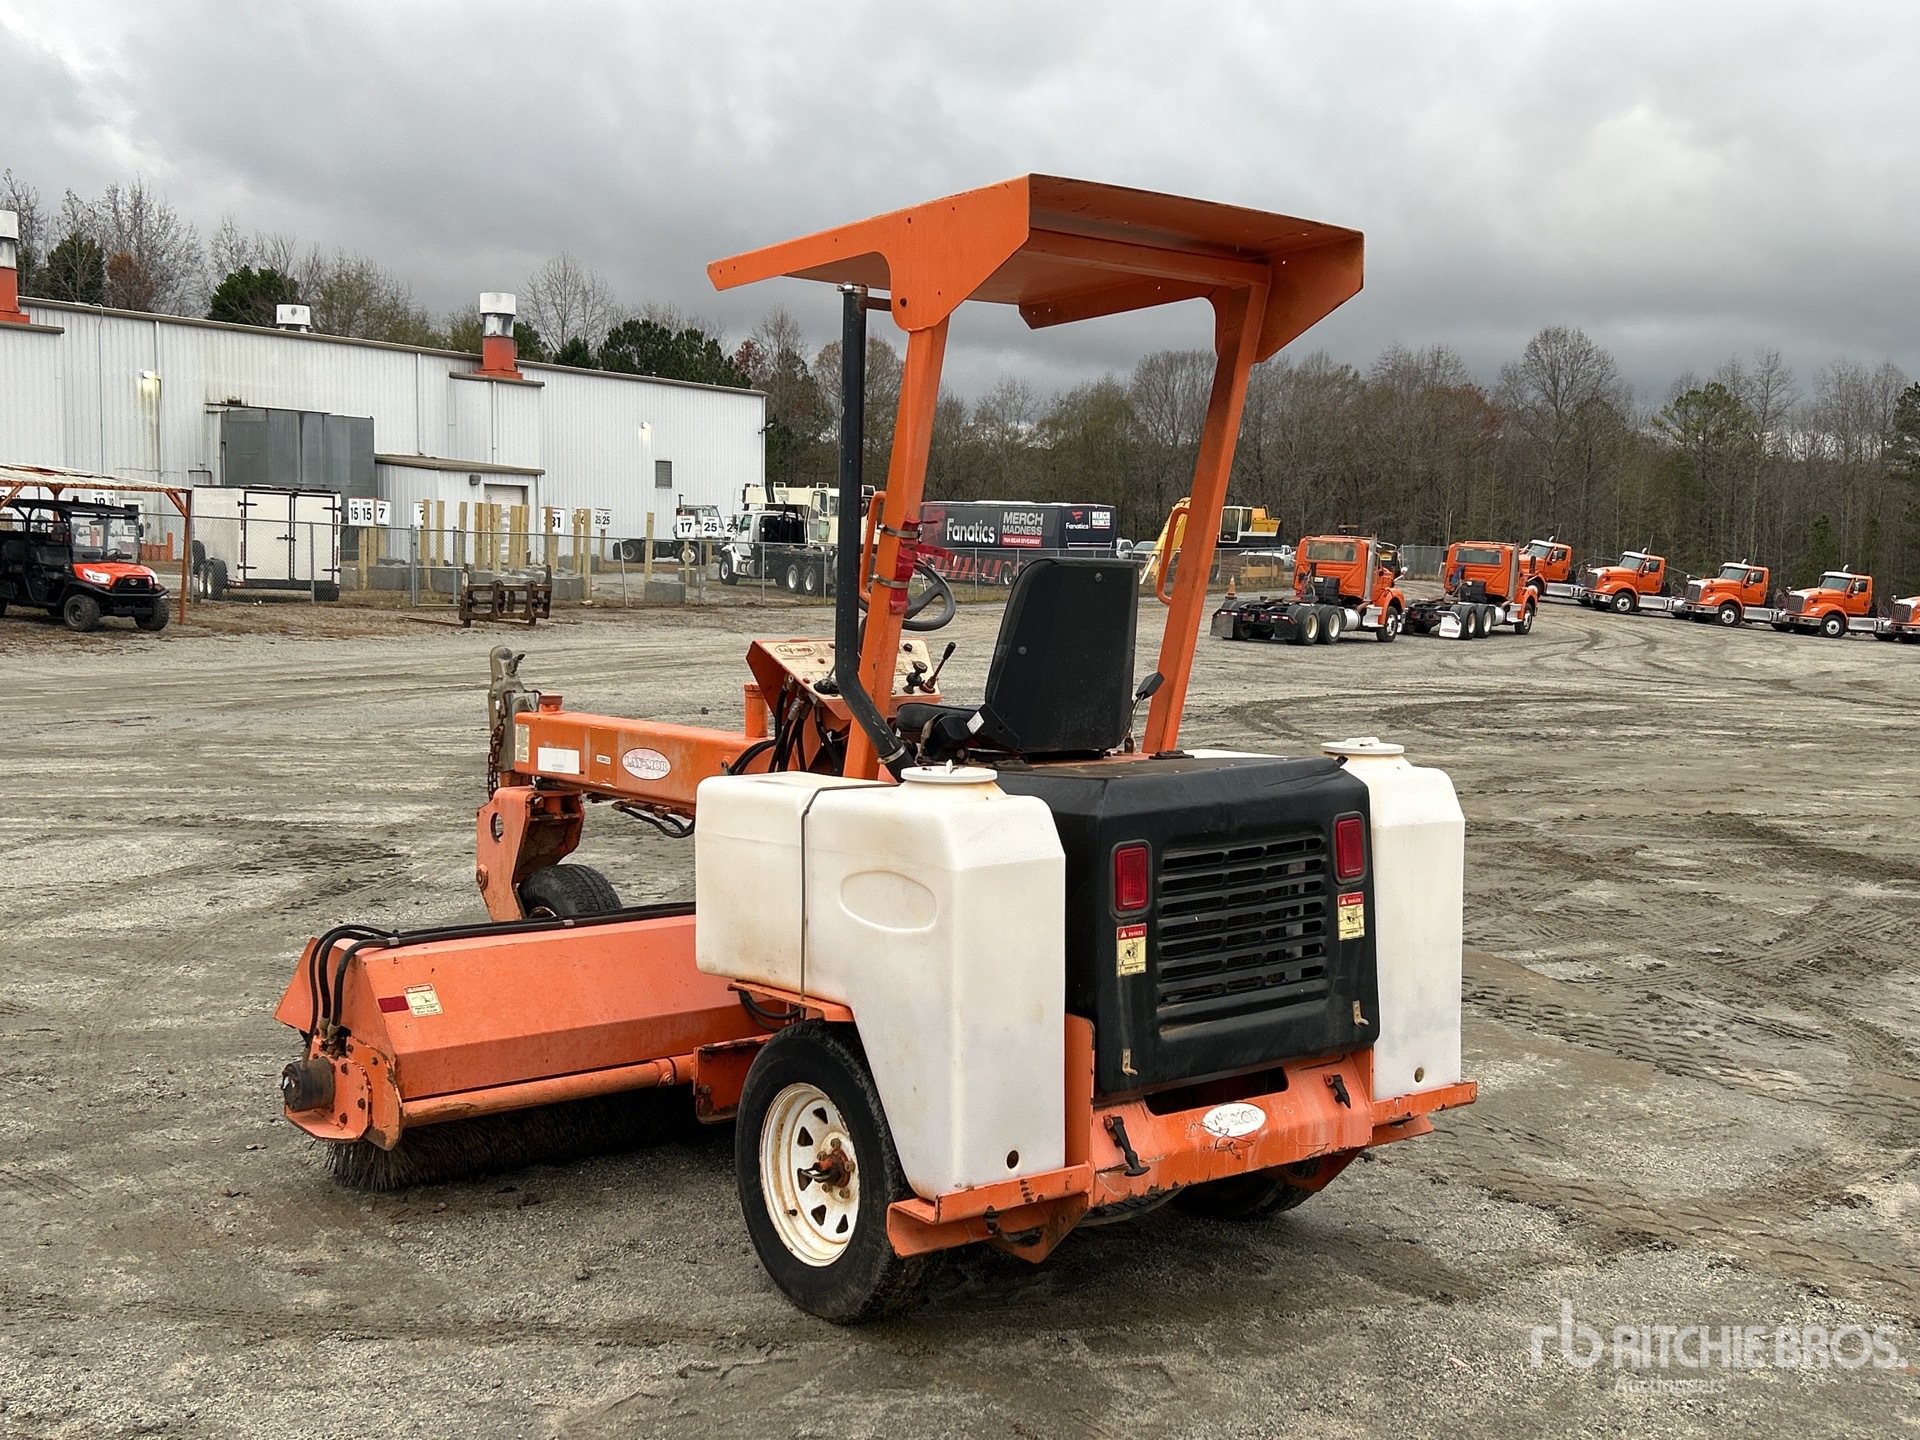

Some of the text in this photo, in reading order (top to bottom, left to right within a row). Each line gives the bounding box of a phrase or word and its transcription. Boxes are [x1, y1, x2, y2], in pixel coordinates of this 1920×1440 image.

[350, 507, 359, 520] 15
[362, 507, 372, 520] 15
[378, 508, 386, 519] 7
[1003, 511, 1044, 526] MERCH
[602, 515, 610, 525] 25
[680, 522, 692, 533] 17
[704, 522, 718, 533] 25
[946, 518, 996, 544] Fanatics
[1002, 524, 1043, 536] MADNESS
[1065, 522, 1089, 530] Fanatics
